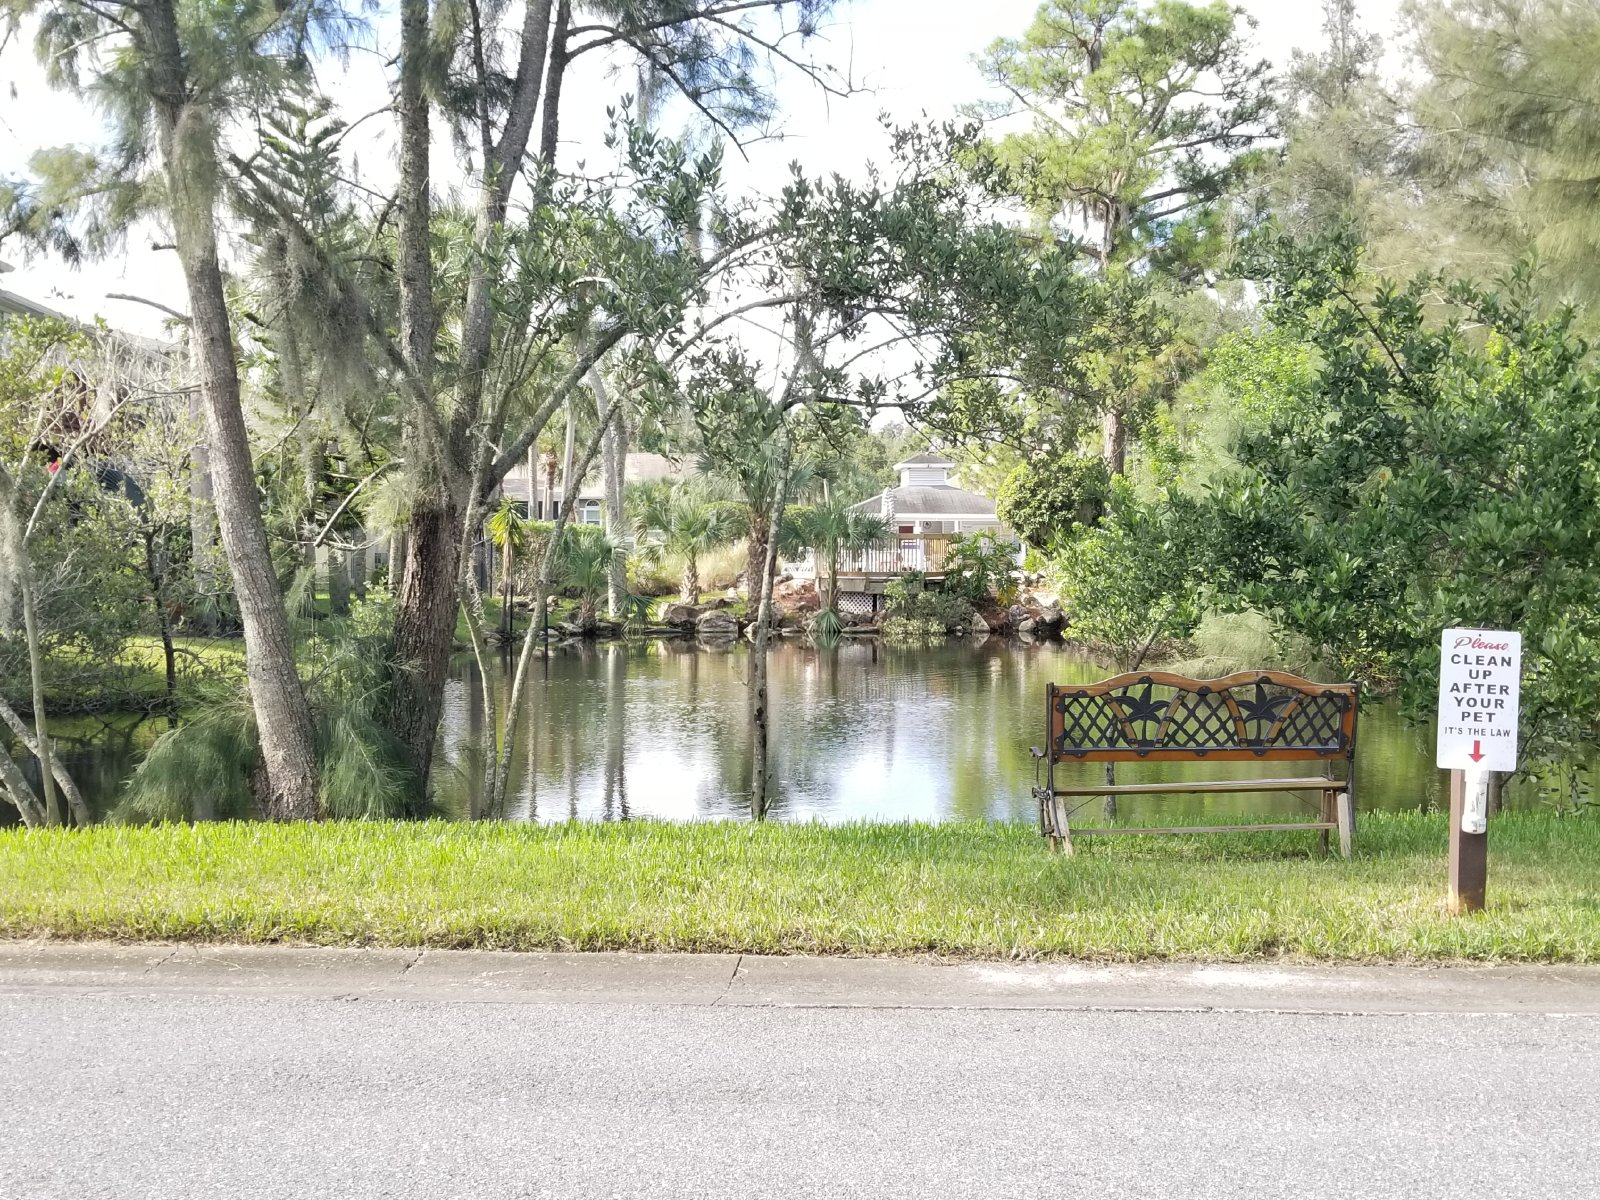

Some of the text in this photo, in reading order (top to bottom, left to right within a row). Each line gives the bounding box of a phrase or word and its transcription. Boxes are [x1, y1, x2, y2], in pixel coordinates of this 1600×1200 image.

[1454, 636, 1509, 650] Please
[1451, 654, 1512, 667] CLEAN
[1468, 669, 1492, 680] UP
[1449, 682, 1510, 696] AFTER
[1453, 696, 1505, 710] YOUR
[1461, 711, 1496, 723] PET
[1444, 726, 1511, 738] IT'S THE LAW
